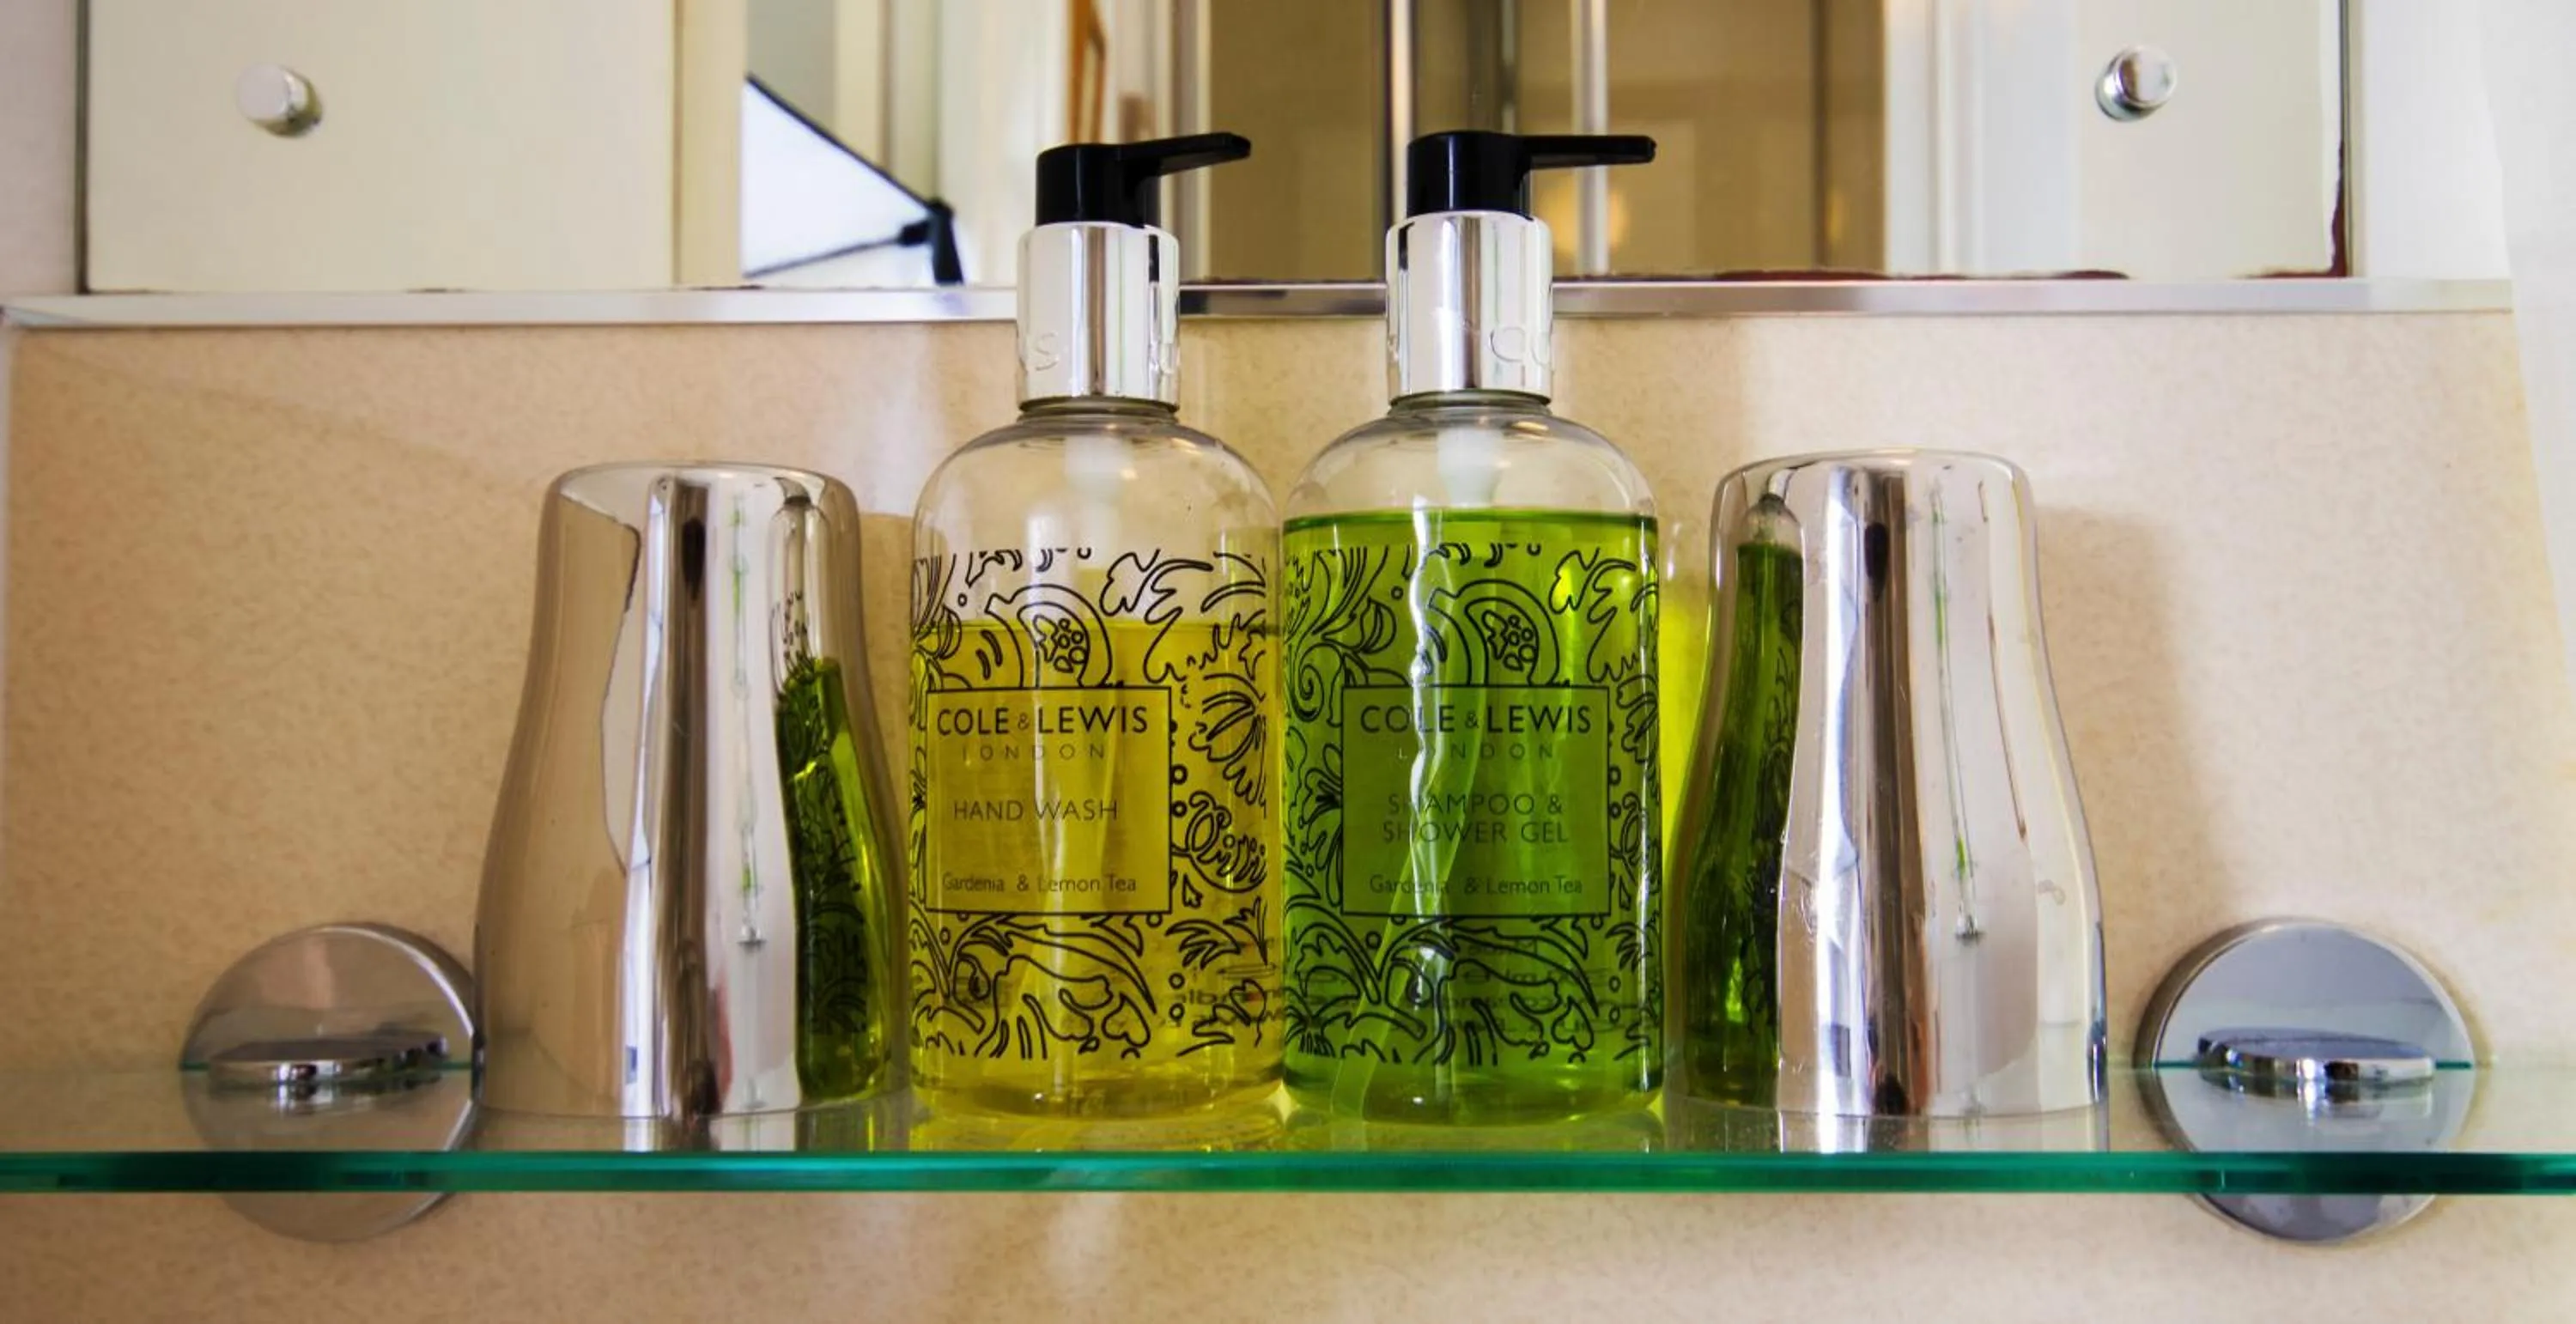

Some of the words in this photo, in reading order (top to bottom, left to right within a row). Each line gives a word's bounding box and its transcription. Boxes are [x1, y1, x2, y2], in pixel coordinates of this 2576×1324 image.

[937, 708, 1010, 736] COLE
[1018, 713, 1030, 730] &
[1037, 706, 1149, 733] LEWIS
[1360, 705, 1455, 733] COLE
[1465, 710, 1479, 729] &
[1487, 705, 1592, 733] LEWIS
[1397, 742, 1554, 760] LNDON
[953, 799, 1024, 821] HAND
[1034, 799, 1118, 821] WASH
[1547, 794, 1563, 815] &
[1382, 820, 1508, 844] SHOWER
[1521, 820, 1570, 843] GEL
[941, 873, 1005, 892] Gardenia
[1016, 874, 1030, 892] &
[1037, 874, 1101, 892] Lemon
[1104, 873, 1137, 892] Tea
[1464, 876, 1478, 895] &
[1486, 876, 1551, 894] Lemon
[1553, 874, 1583, 894] Tea
